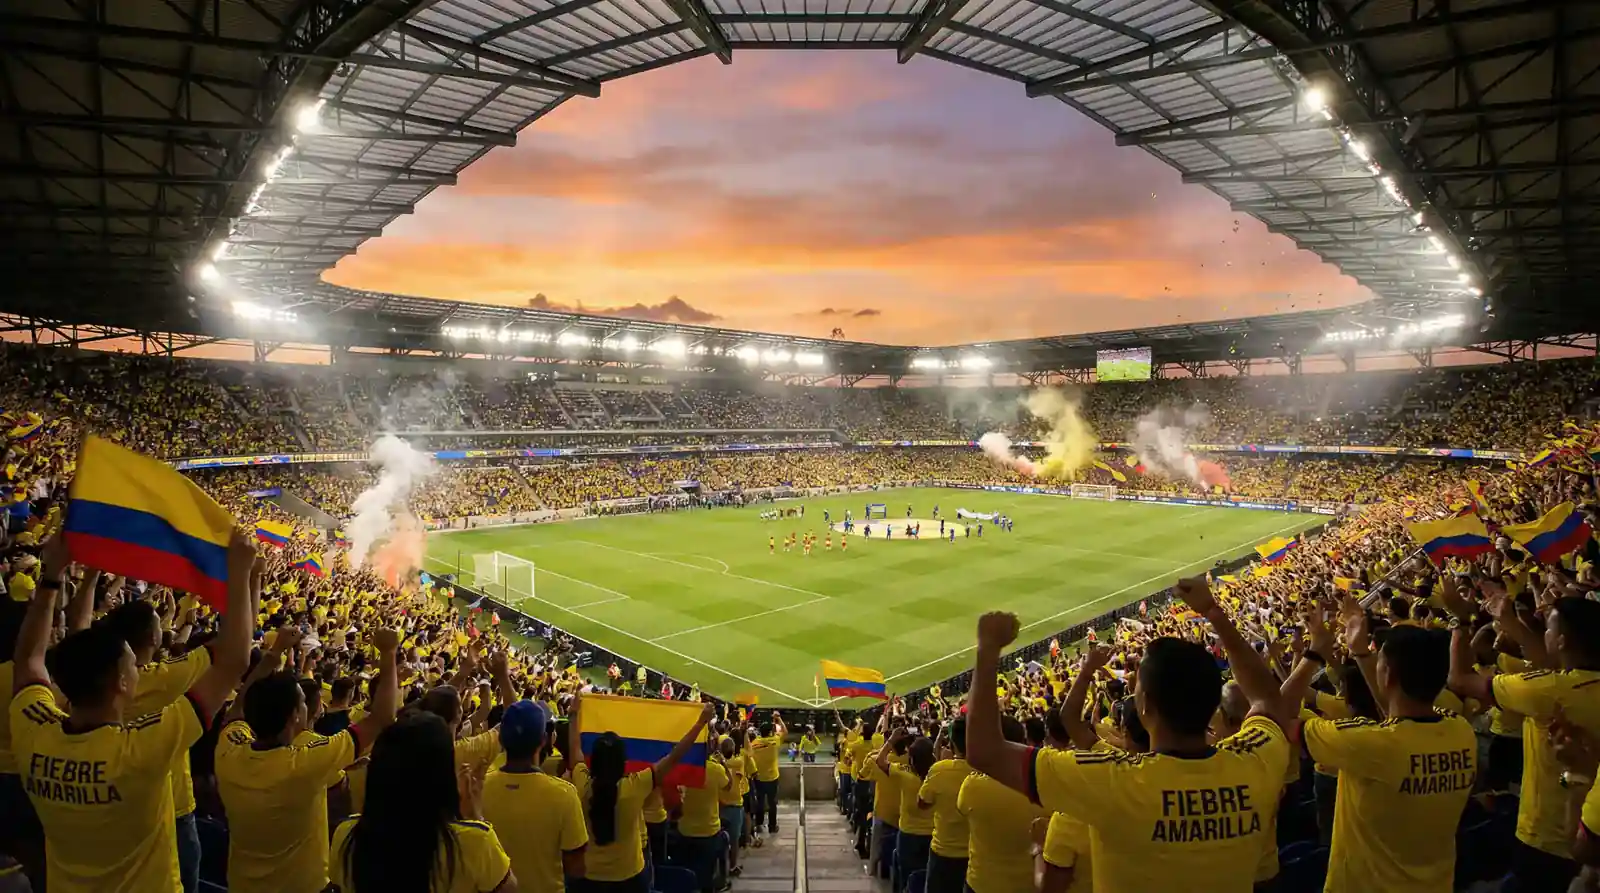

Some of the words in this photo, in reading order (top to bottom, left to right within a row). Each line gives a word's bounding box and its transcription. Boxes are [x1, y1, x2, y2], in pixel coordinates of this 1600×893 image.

[31, 753, 107, 783] FIEBRE
[1410, 749, 1473, 775] FIEBRE
[27, 777, 122, 804] AMARILLA
[1162, 785, 1252, 816] FIEBRE
[1151, 812, 1261, 842] AMARILLA
